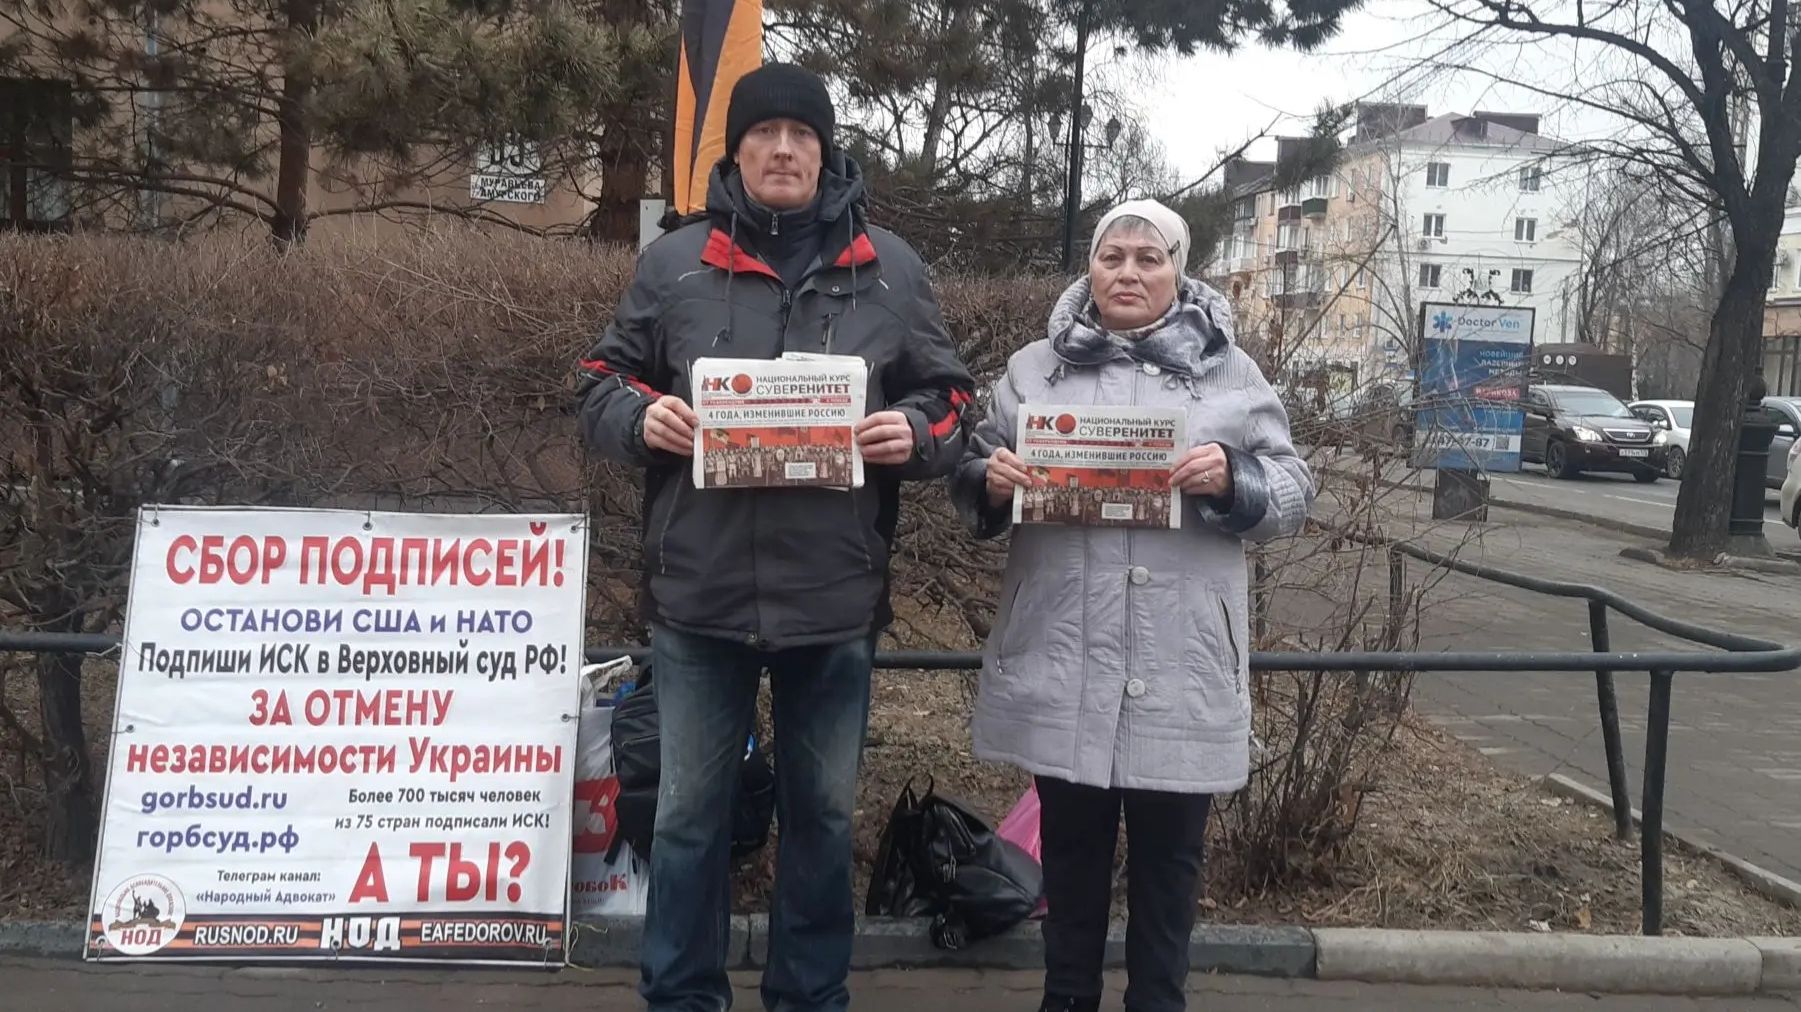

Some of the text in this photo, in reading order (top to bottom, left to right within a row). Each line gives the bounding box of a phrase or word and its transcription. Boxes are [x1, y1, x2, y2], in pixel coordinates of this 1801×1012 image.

[1457, 315, 1520, 329] Doctor Ven
[756, 374, 827, 383] НАЦИОНАЛЬНЫЙ
[829, 374, 850, 383] КУРС
[756, 383, 850, 395] СУВЕРЕНИТЕТ
[715, 410, 741, 420] ГОДА,
[743, 408, 806, 419] ИЗМЕНИВШИЕ
[808, 408, 845, 418] РОССИЮ
[1080, 416, 1151, 426] НАЦИОНАЛЬНЫЙ
[1153, 419, 1175, 427] КУРС
[1079, 426, 1175, 438] СУВЕРЕНИТЕТ
[1038, 450, 1063, 459] ГОДА,
[1064, 450, 1127, 460] ИЗМЕНИВШИЕ
[1129, 452, 1167, 461] РОССИЮ
[166, 522, 567, 596] СБОР ПОДПИСЕЙ!
[180, 608, 533, 634] ОСТАНОВИ США и НАТО
[138, 639, 567, 682] Подпиши ИСК в Верховный суд РФ!
[248, 689, 454, 727] ЗА ОТМЕНУ
[126, 736, 562, 783] независимости Украины
[141, 784, 288, 815] gorbsud.ru
[348, 787, 541, 804] Более 700 тысяч человек
[334, 812, 550, 832] из 75 стран подписали ИСК!
[136, 823, 300, 854] горбсуд.рф
[217, 870, 321, 885] Телеграм канал:
[348, 840, 531, 904] А ТЫ?
[196, 889, 336, 906] «Народный Адвокат»
[121, 929, 161, 946] НОД
[194, 925, 299, 946] RUSNOD.RU
[321, 916, 401, 950] НОД
[421, 925, 547, 945] EAFEDOROV.RU
